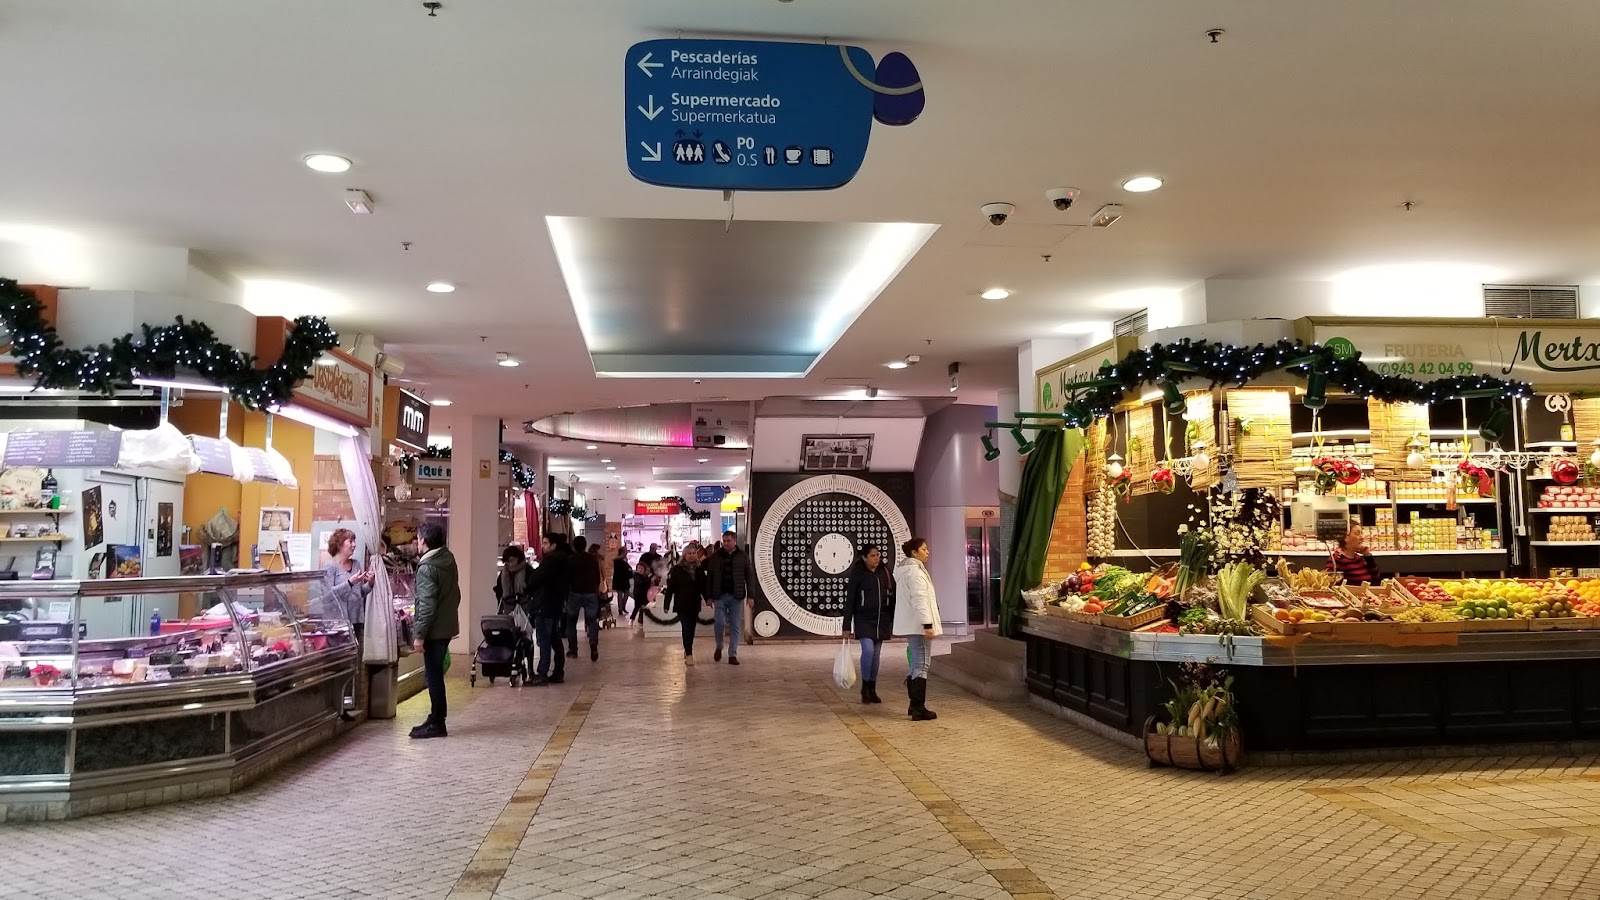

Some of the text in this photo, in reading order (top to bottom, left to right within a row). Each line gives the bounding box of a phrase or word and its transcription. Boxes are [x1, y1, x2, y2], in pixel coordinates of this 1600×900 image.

[671, 50, 758, 64] Pescaderías
[671, 66, 758, 83] Arraindegiak
[671, 92, 780, 108] Supermercado
[671, 109, 776, 125] Supermerkatua
[1384, 343, 1465, 358] FRUTERIA
[1390, 362, 1474, 375] 943 42 04 99
[402, 405, 424, 434] mm
